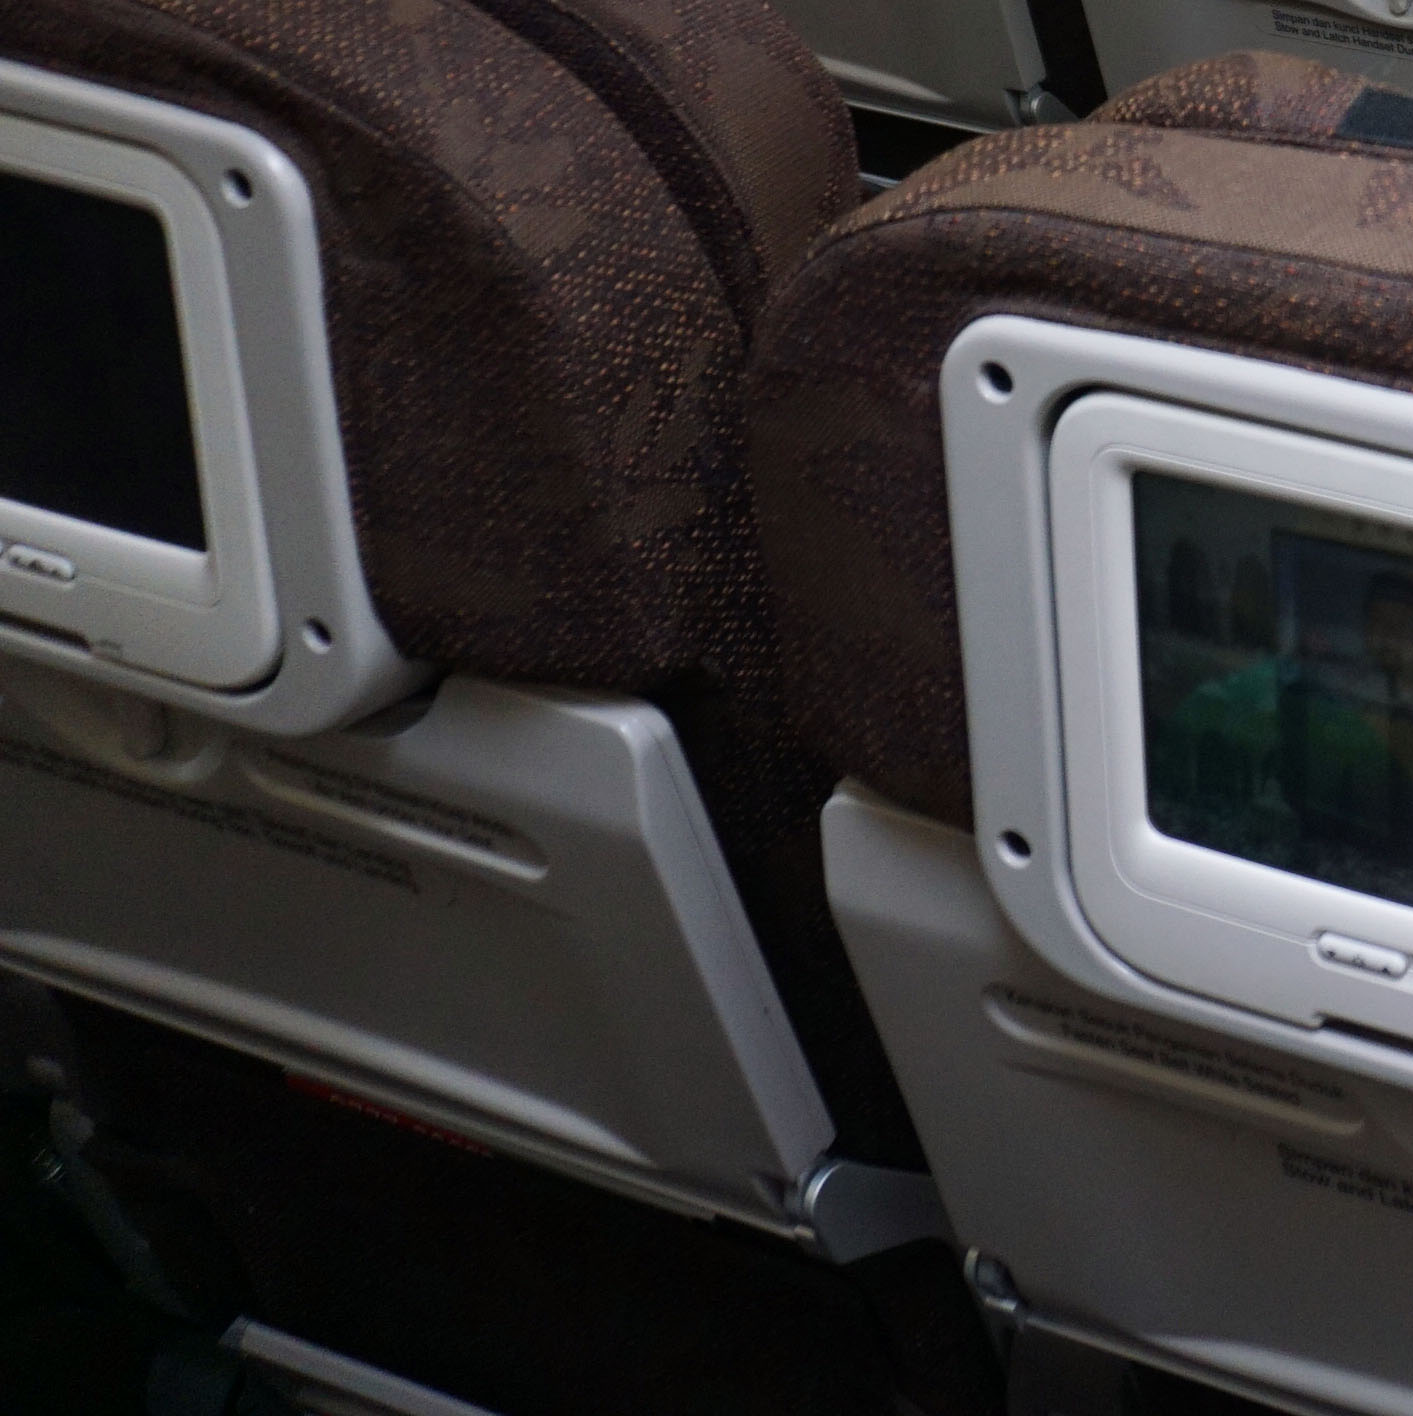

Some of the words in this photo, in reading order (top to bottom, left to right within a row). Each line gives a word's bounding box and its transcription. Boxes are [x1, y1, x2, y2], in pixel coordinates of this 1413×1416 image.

[1272, 9, 1310, 25] Simpan
[1312, 17, 1331, 29] dan
[1302, 27, 1320, 38] and
[1323, 31, 1350, 43] Latch
[1352, 36, 1394, 53] Handset
